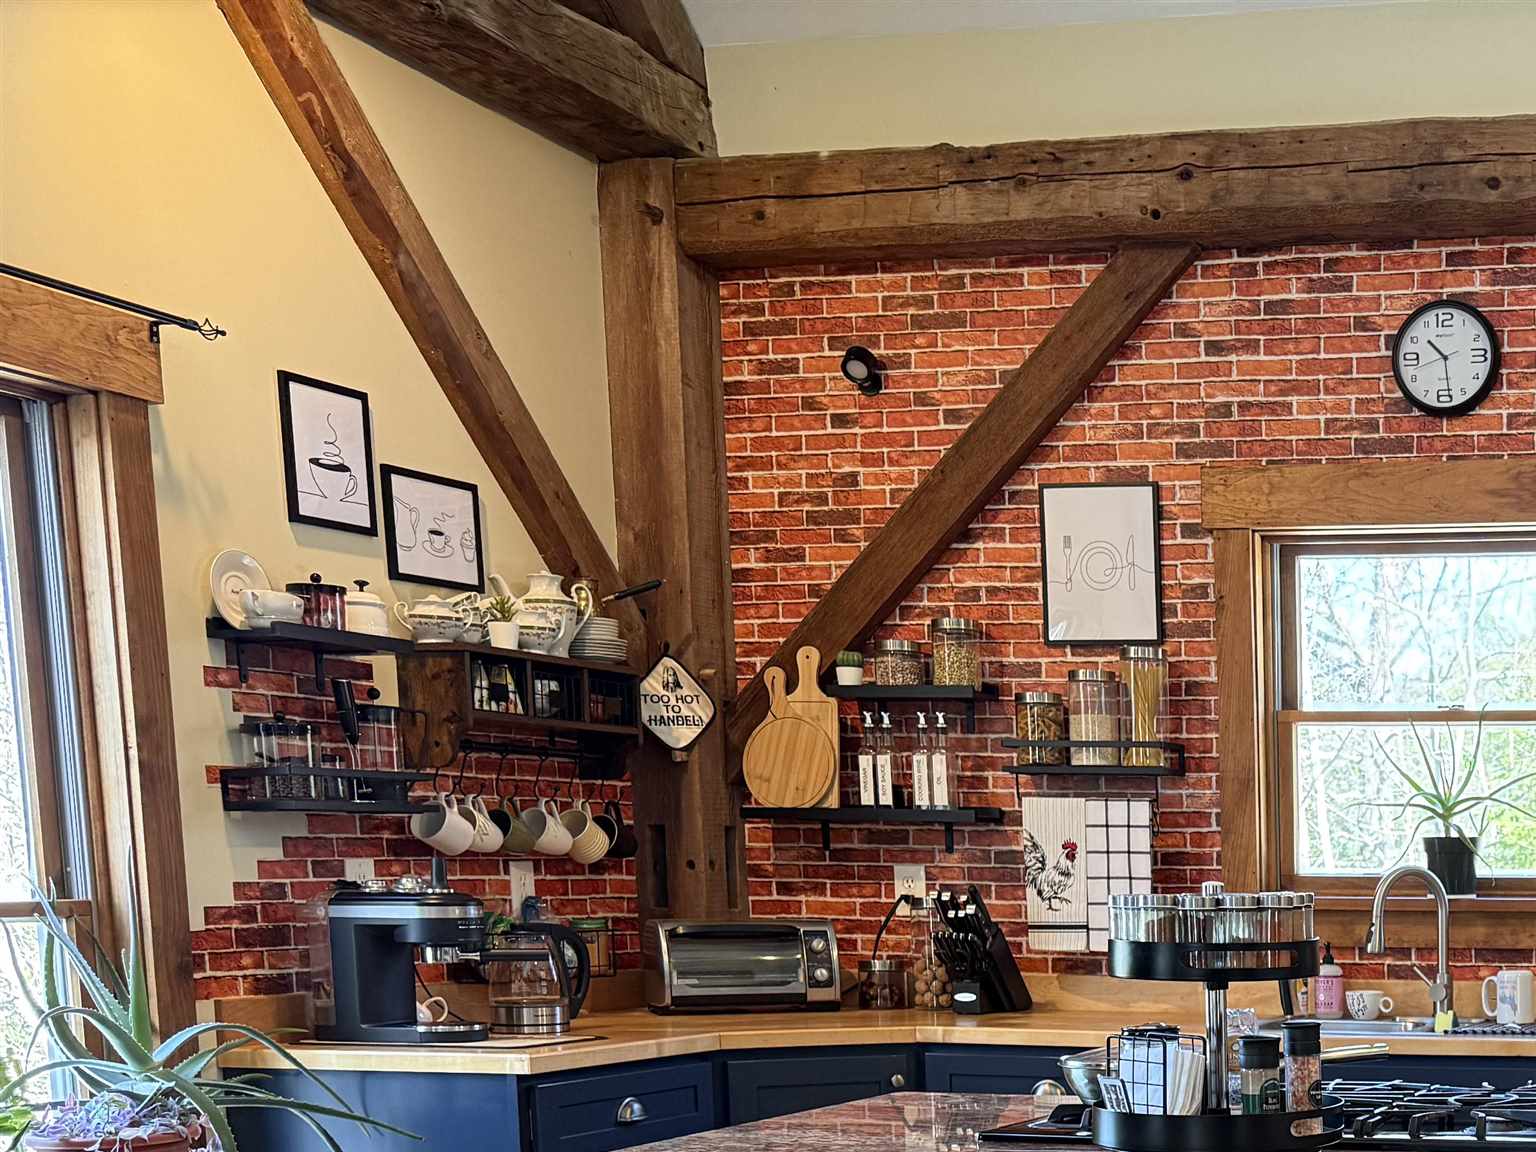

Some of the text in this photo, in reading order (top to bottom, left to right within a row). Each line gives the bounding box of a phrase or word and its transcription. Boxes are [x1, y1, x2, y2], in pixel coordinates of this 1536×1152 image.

[1423, 320, 1430, 328] 11
[1434, 312, 1454, 328] 12
[1410, 336, 1419, 344] 10
[1473, 334, 1481, 343] 2
[1403, 352, 1420, 367] 9
[1470, 348, 1488, 364] 3
[1410, 374, 1417, 383] 8
[1423, 389, 1430, 398] 7
[1436, 388, 1453, 403] 6
[640, 694, 701, 704] TOO HOT
[663, 704, 682, 714] TO
[647, 714, 705, 727] HANDEL!
